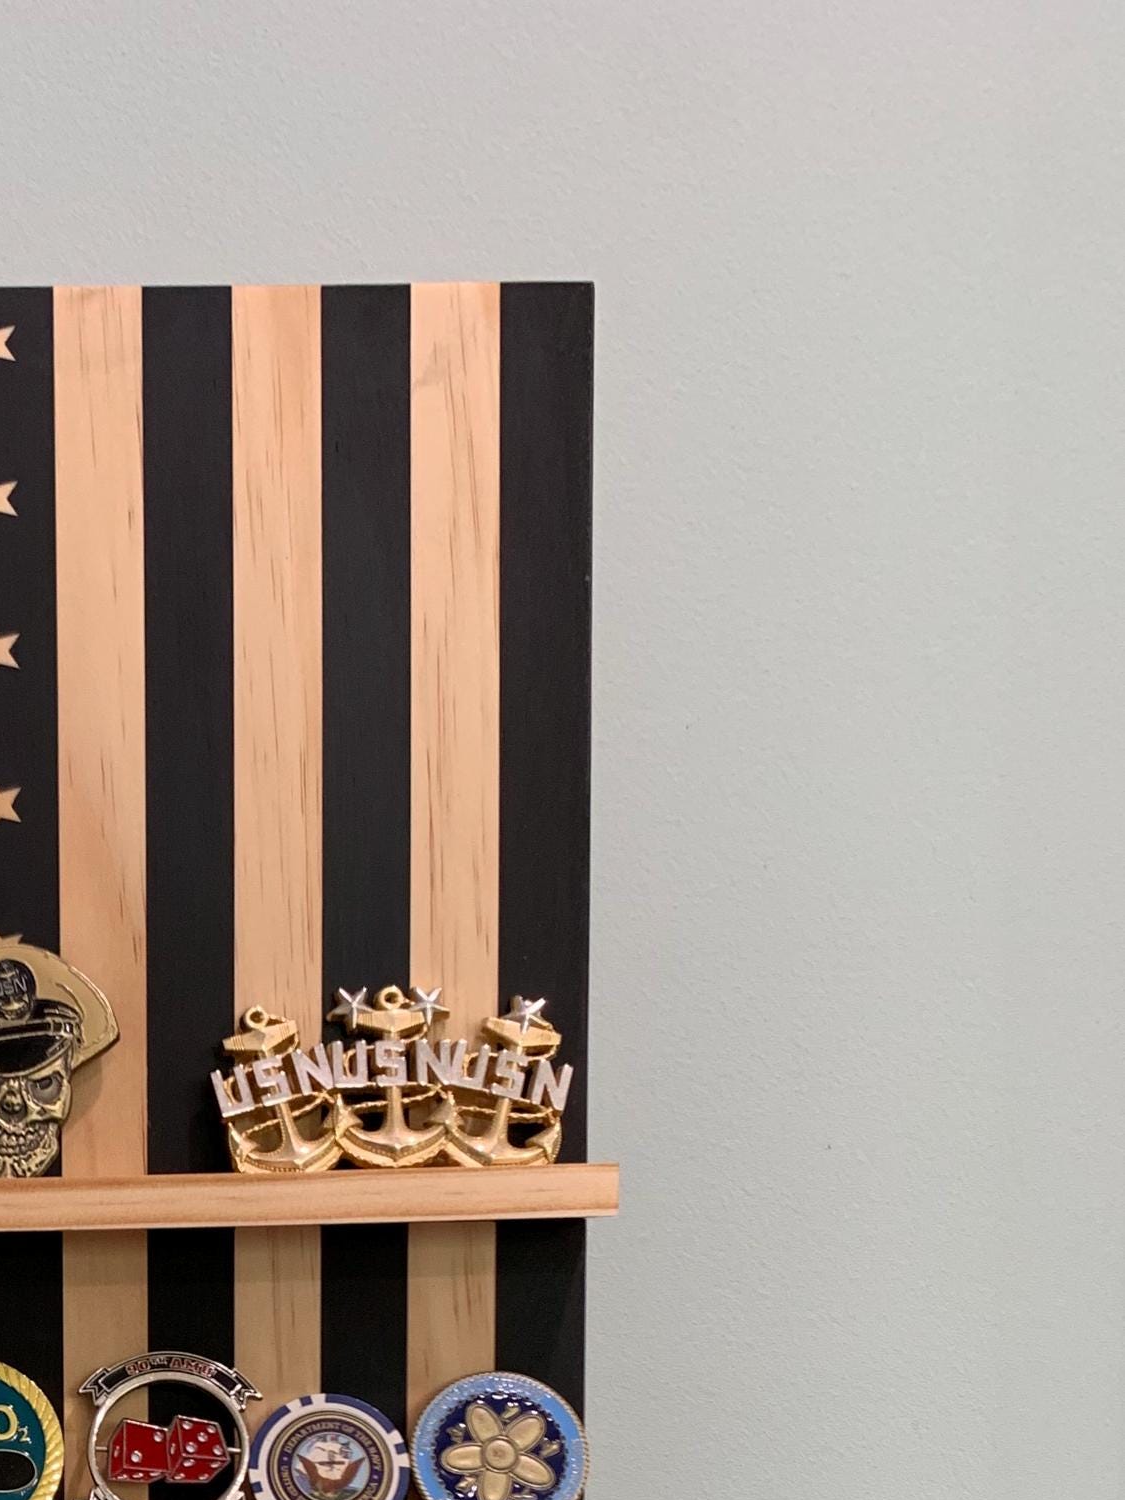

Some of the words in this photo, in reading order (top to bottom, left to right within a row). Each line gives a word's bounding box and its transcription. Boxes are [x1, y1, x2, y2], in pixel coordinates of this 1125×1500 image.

[210, 1042, 334, 1118] USN
[332, 1039, 451, 1089] USN
[448, 1039, 574, 1113] USN
[285, 1421, 341, 1454] DEPARTMENT
[355, 1430, 372, 1446] THE
[368, 1446, 381, 1471] NAVY
